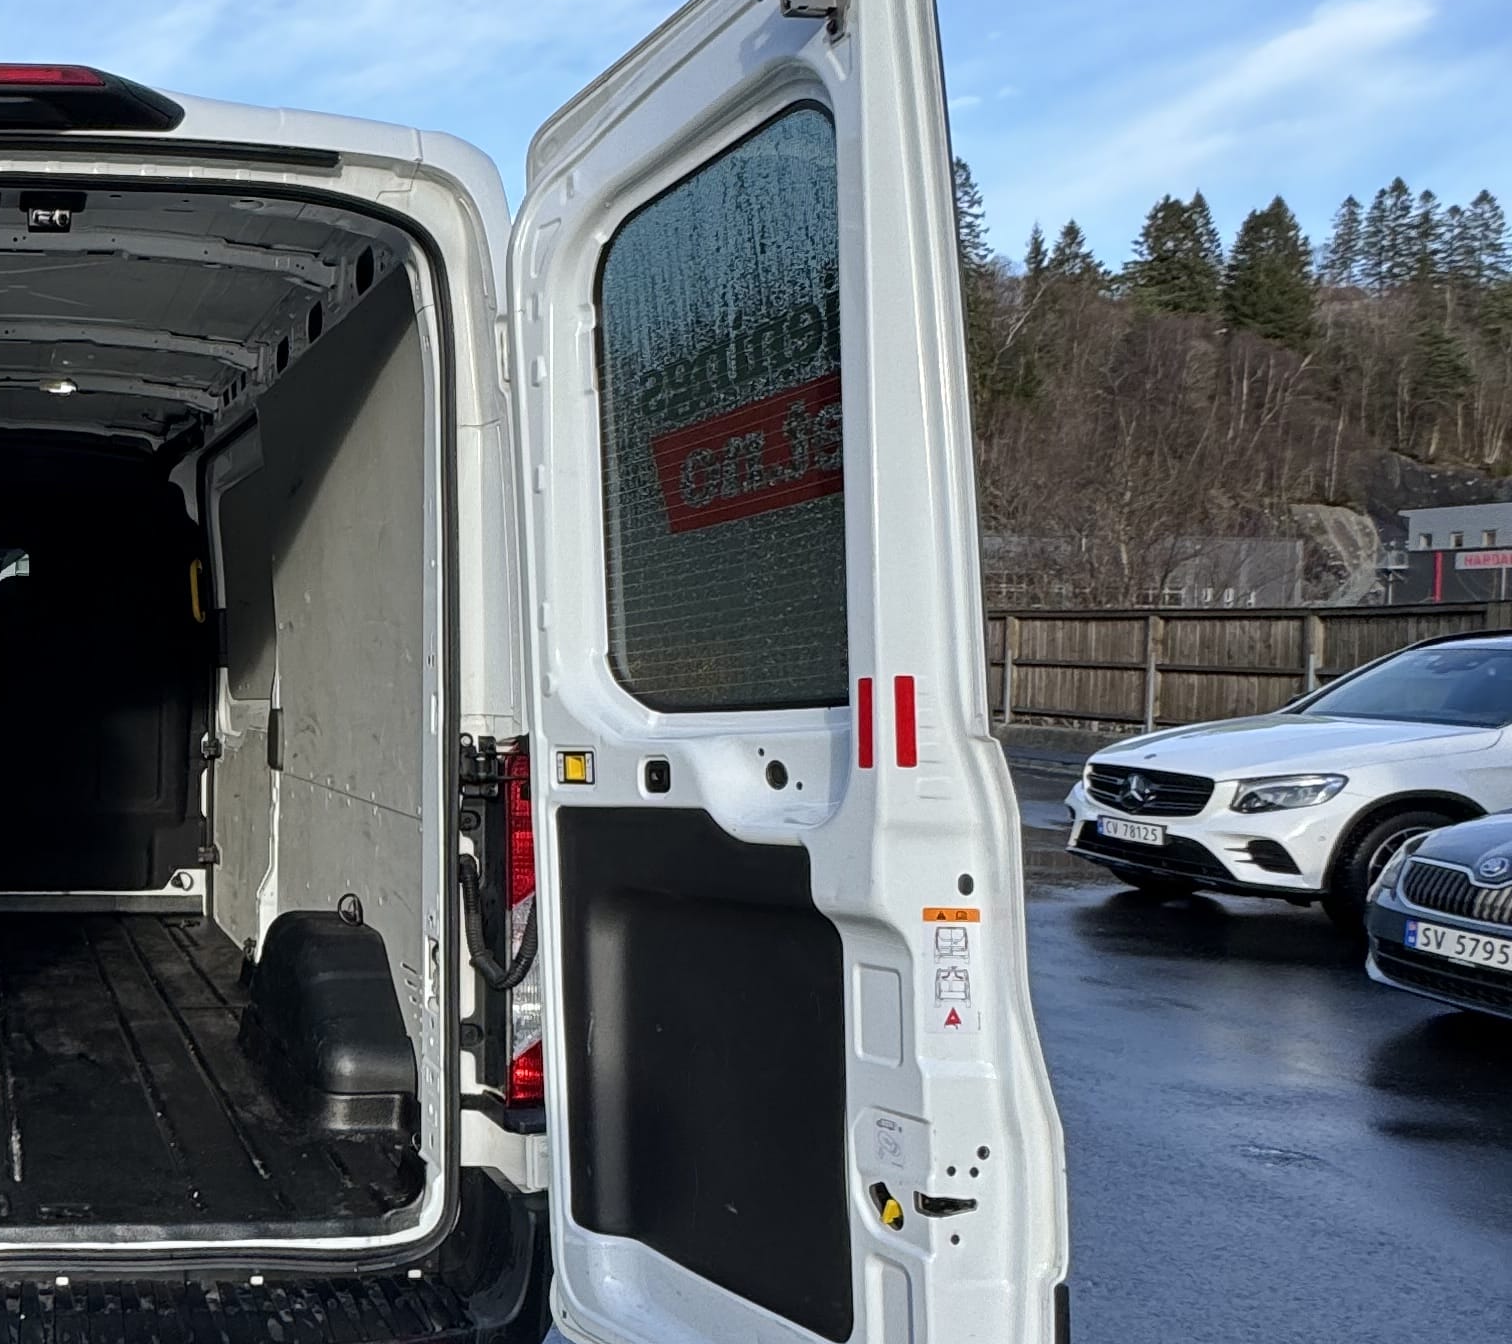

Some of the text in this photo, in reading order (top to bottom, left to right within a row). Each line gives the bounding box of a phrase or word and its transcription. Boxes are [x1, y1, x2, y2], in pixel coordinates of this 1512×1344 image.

[1106, 821, 1157, 842] CV 78125
[1421, 927, 1446, 950] SV
